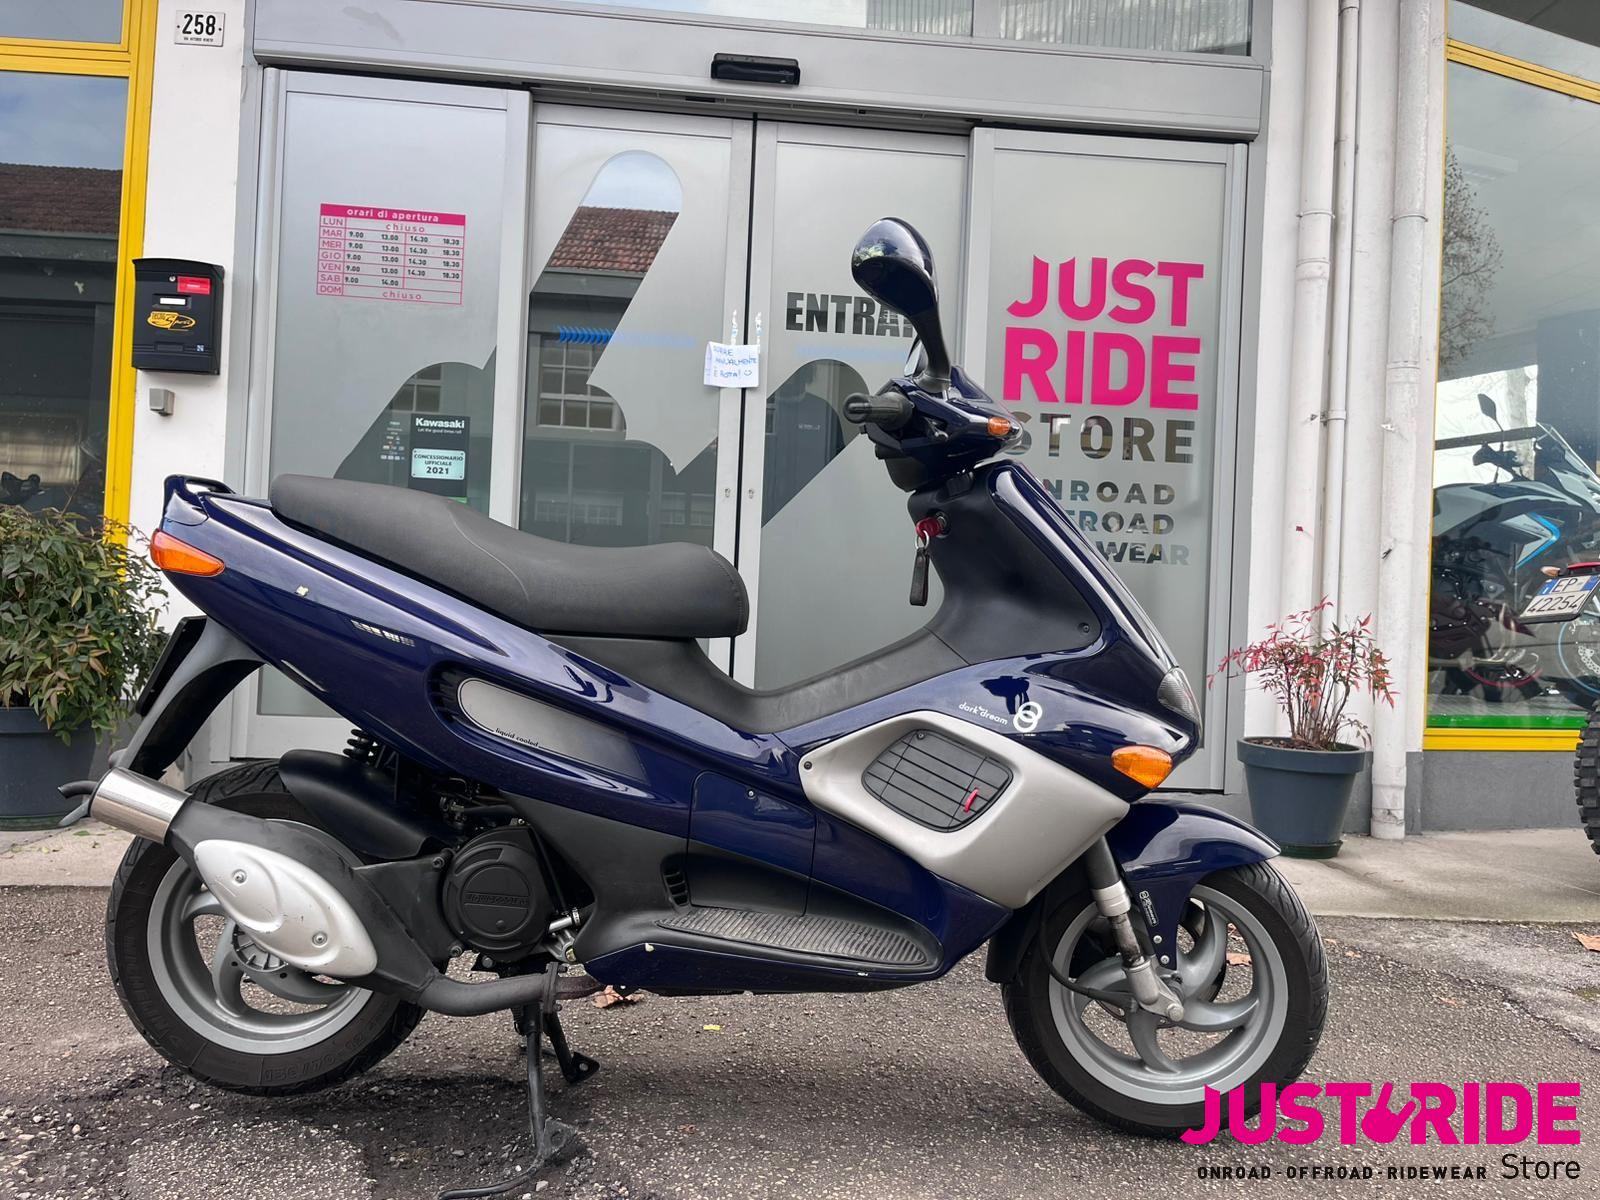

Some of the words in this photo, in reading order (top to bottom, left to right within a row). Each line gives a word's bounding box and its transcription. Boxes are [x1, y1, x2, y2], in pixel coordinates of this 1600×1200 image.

[182, 13, 216, 36] 258
[347, 208, 374, 217] orari
[378, 210, 388, 218] di
[392, 212, 439, 223] apertura
[323, 217, 343, 226] LUN
[386, 224, 425, 232] chiuso
[322, 229, 342, 237] MAR
[410, 235, 429, 243] 14.30
[322, 240, 342, 249] MER
[321, 251, 341, 260] GIO
[321, 263, 341, 271] VEN
[408, 269, 426, 277] 14.30
[320, 274, 340, 282] SAB
[345, 276, 359, 284] 9.00
[320, 285, 342, 293] DOM
[382, 291, 422, 300] chiuso
[1006, 254, 1204, 327] JUST
[1003, 326, 1200, 411] RIDE
[415, 417, 465, 429] Kawasaki
[426, 466, 449, 475] 2021
[1042, 479, 1176, 505] NROAD
[1064, 509, 1175, 535] ROAD
[1095, 541, 1190, 566] WEAR
[1552, 577, 1578, 593] EP
[1527, 593, 1585, 613] 42254
[959, 701, 980, 714] dark
[980, 709, 1008, 725] dream
[495, 728, 515, 738] liquid
[516, 737, 538, 746] cooled
